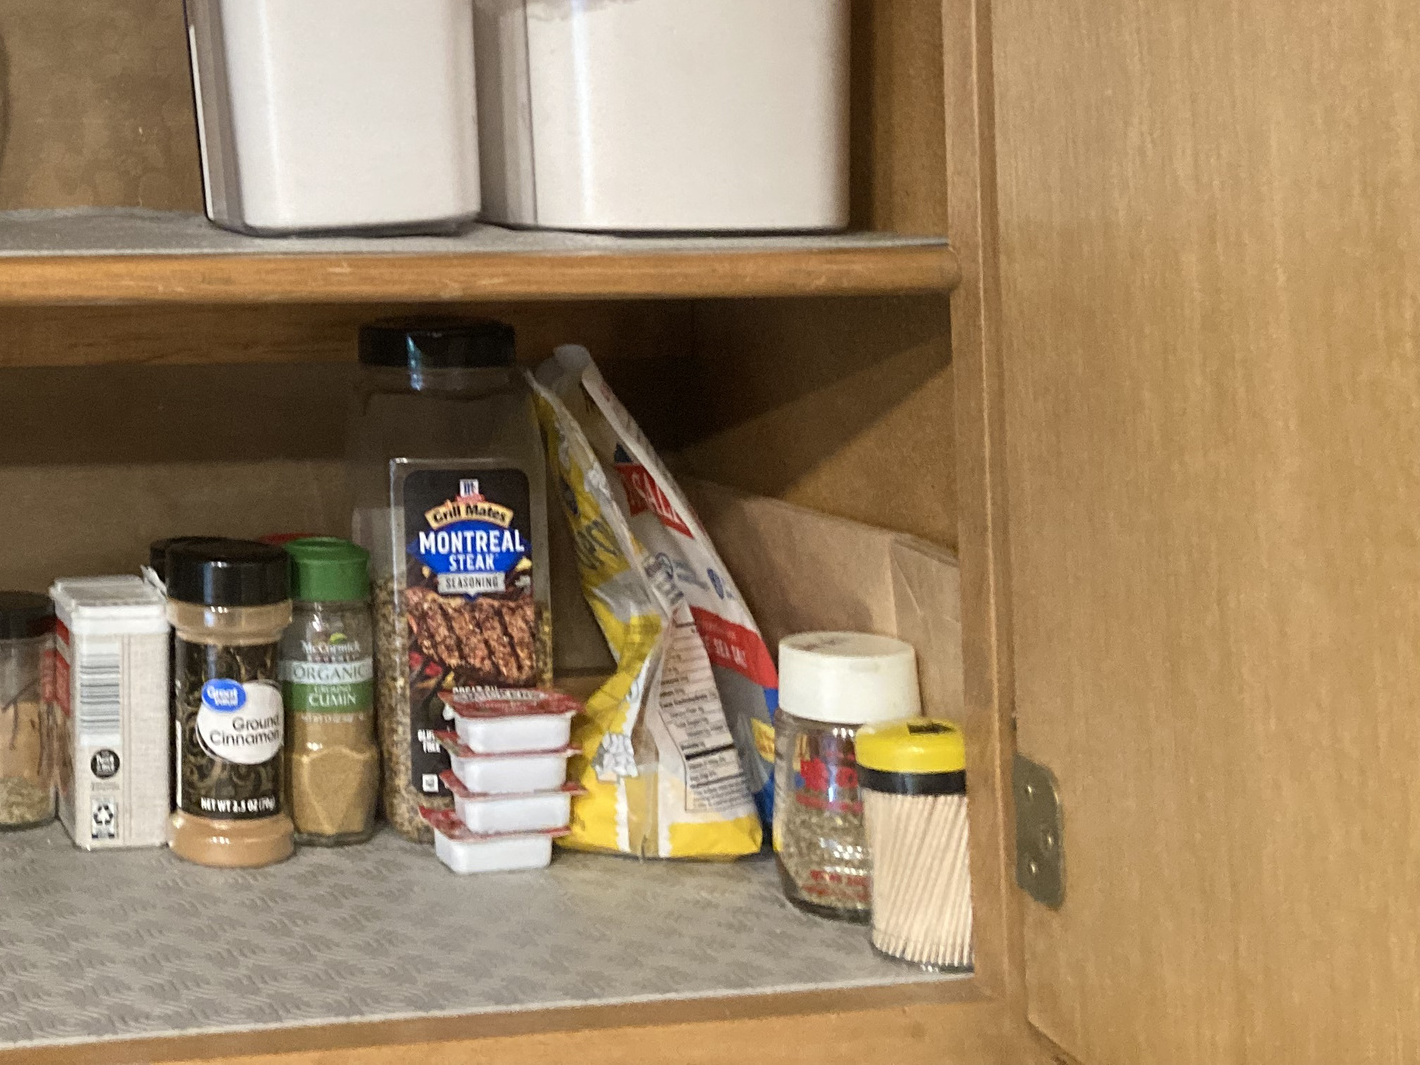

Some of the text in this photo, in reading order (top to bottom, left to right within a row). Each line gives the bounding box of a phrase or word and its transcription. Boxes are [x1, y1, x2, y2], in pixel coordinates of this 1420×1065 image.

[433, 501, 507, 523] Grill Mates
[418, 529, 525, 555] MONTREAL
[448, 553, 495, 572] STEAK
[445, 576, 499, 590] SEASONING
[293, 663, 365, 681] ORGANIC
[206, 685, 238, 699] Great
[309, 693, 357, 707] CUMIN
[232, 715, 280, 732] Ground
[210, 729, 280, 747] Cinnamon
[200, 796, 217, 812] NET
[217, 799, 231, 813] WT
[247, 798, 259, 813] OZ
